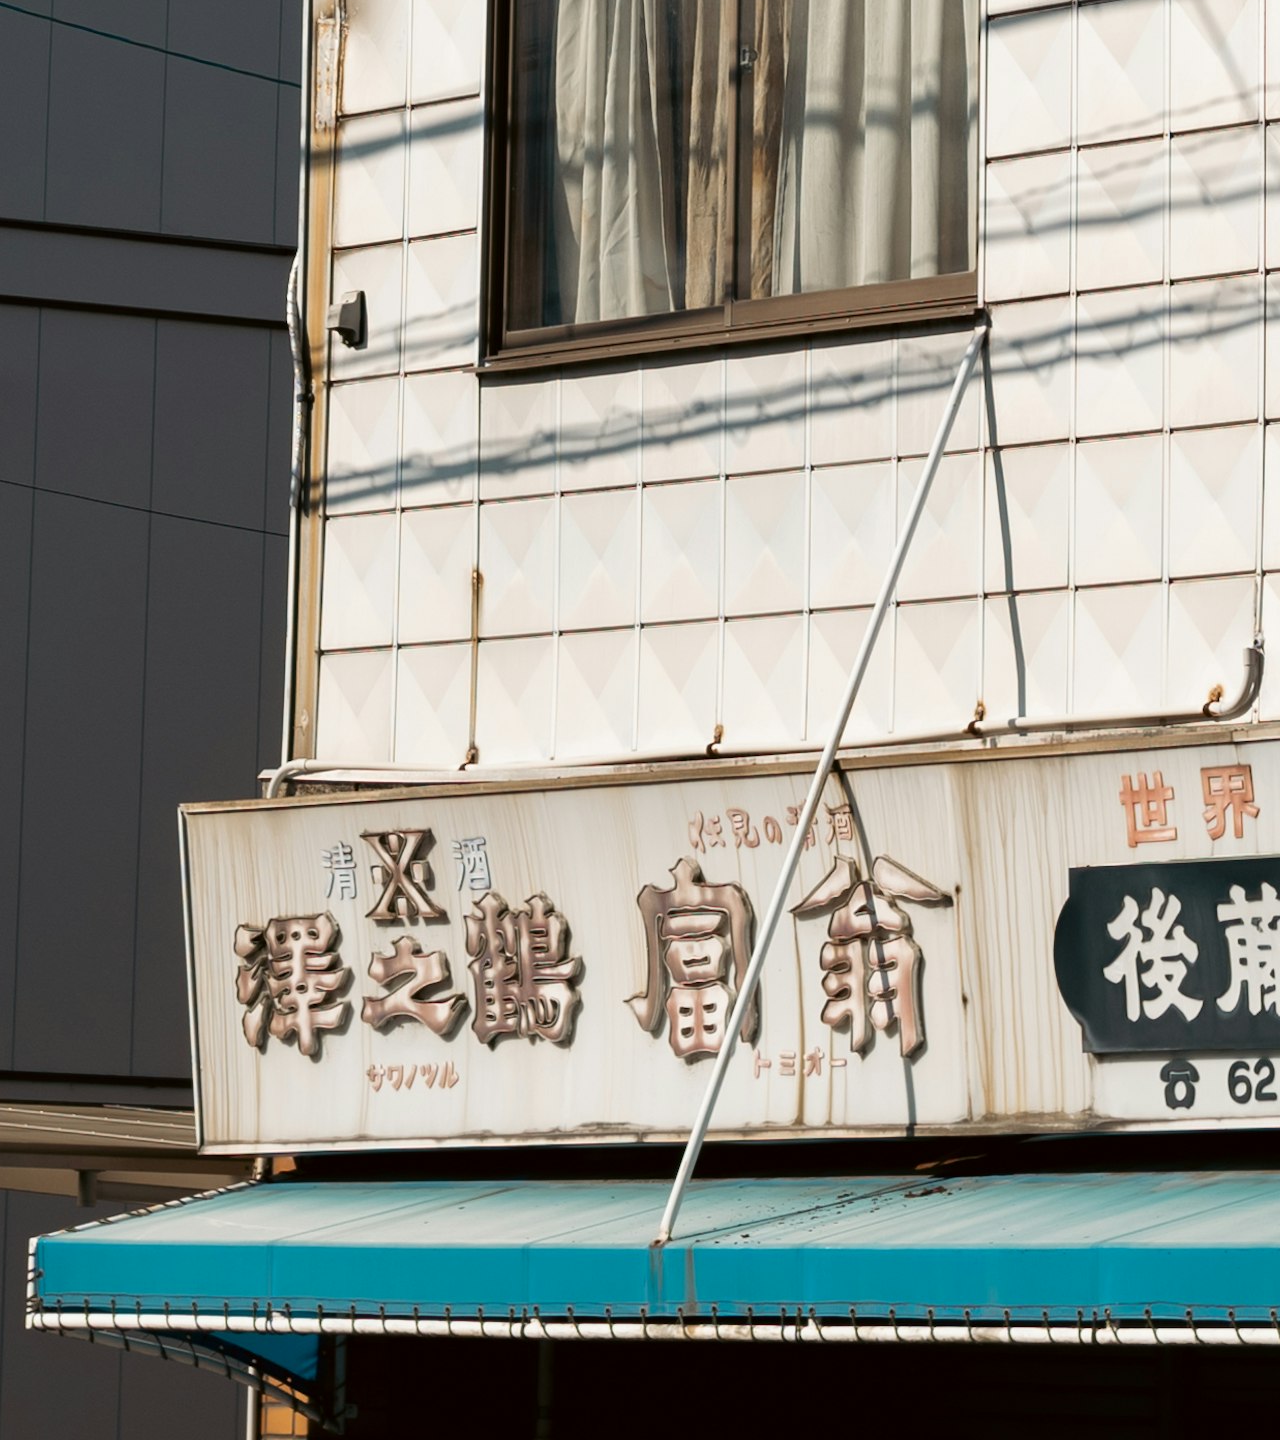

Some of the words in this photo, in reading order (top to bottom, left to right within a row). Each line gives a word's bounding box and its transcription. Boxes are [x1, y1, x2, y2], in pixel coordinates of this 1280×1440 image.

[366, 1060, 460, 1092] サワノツル
